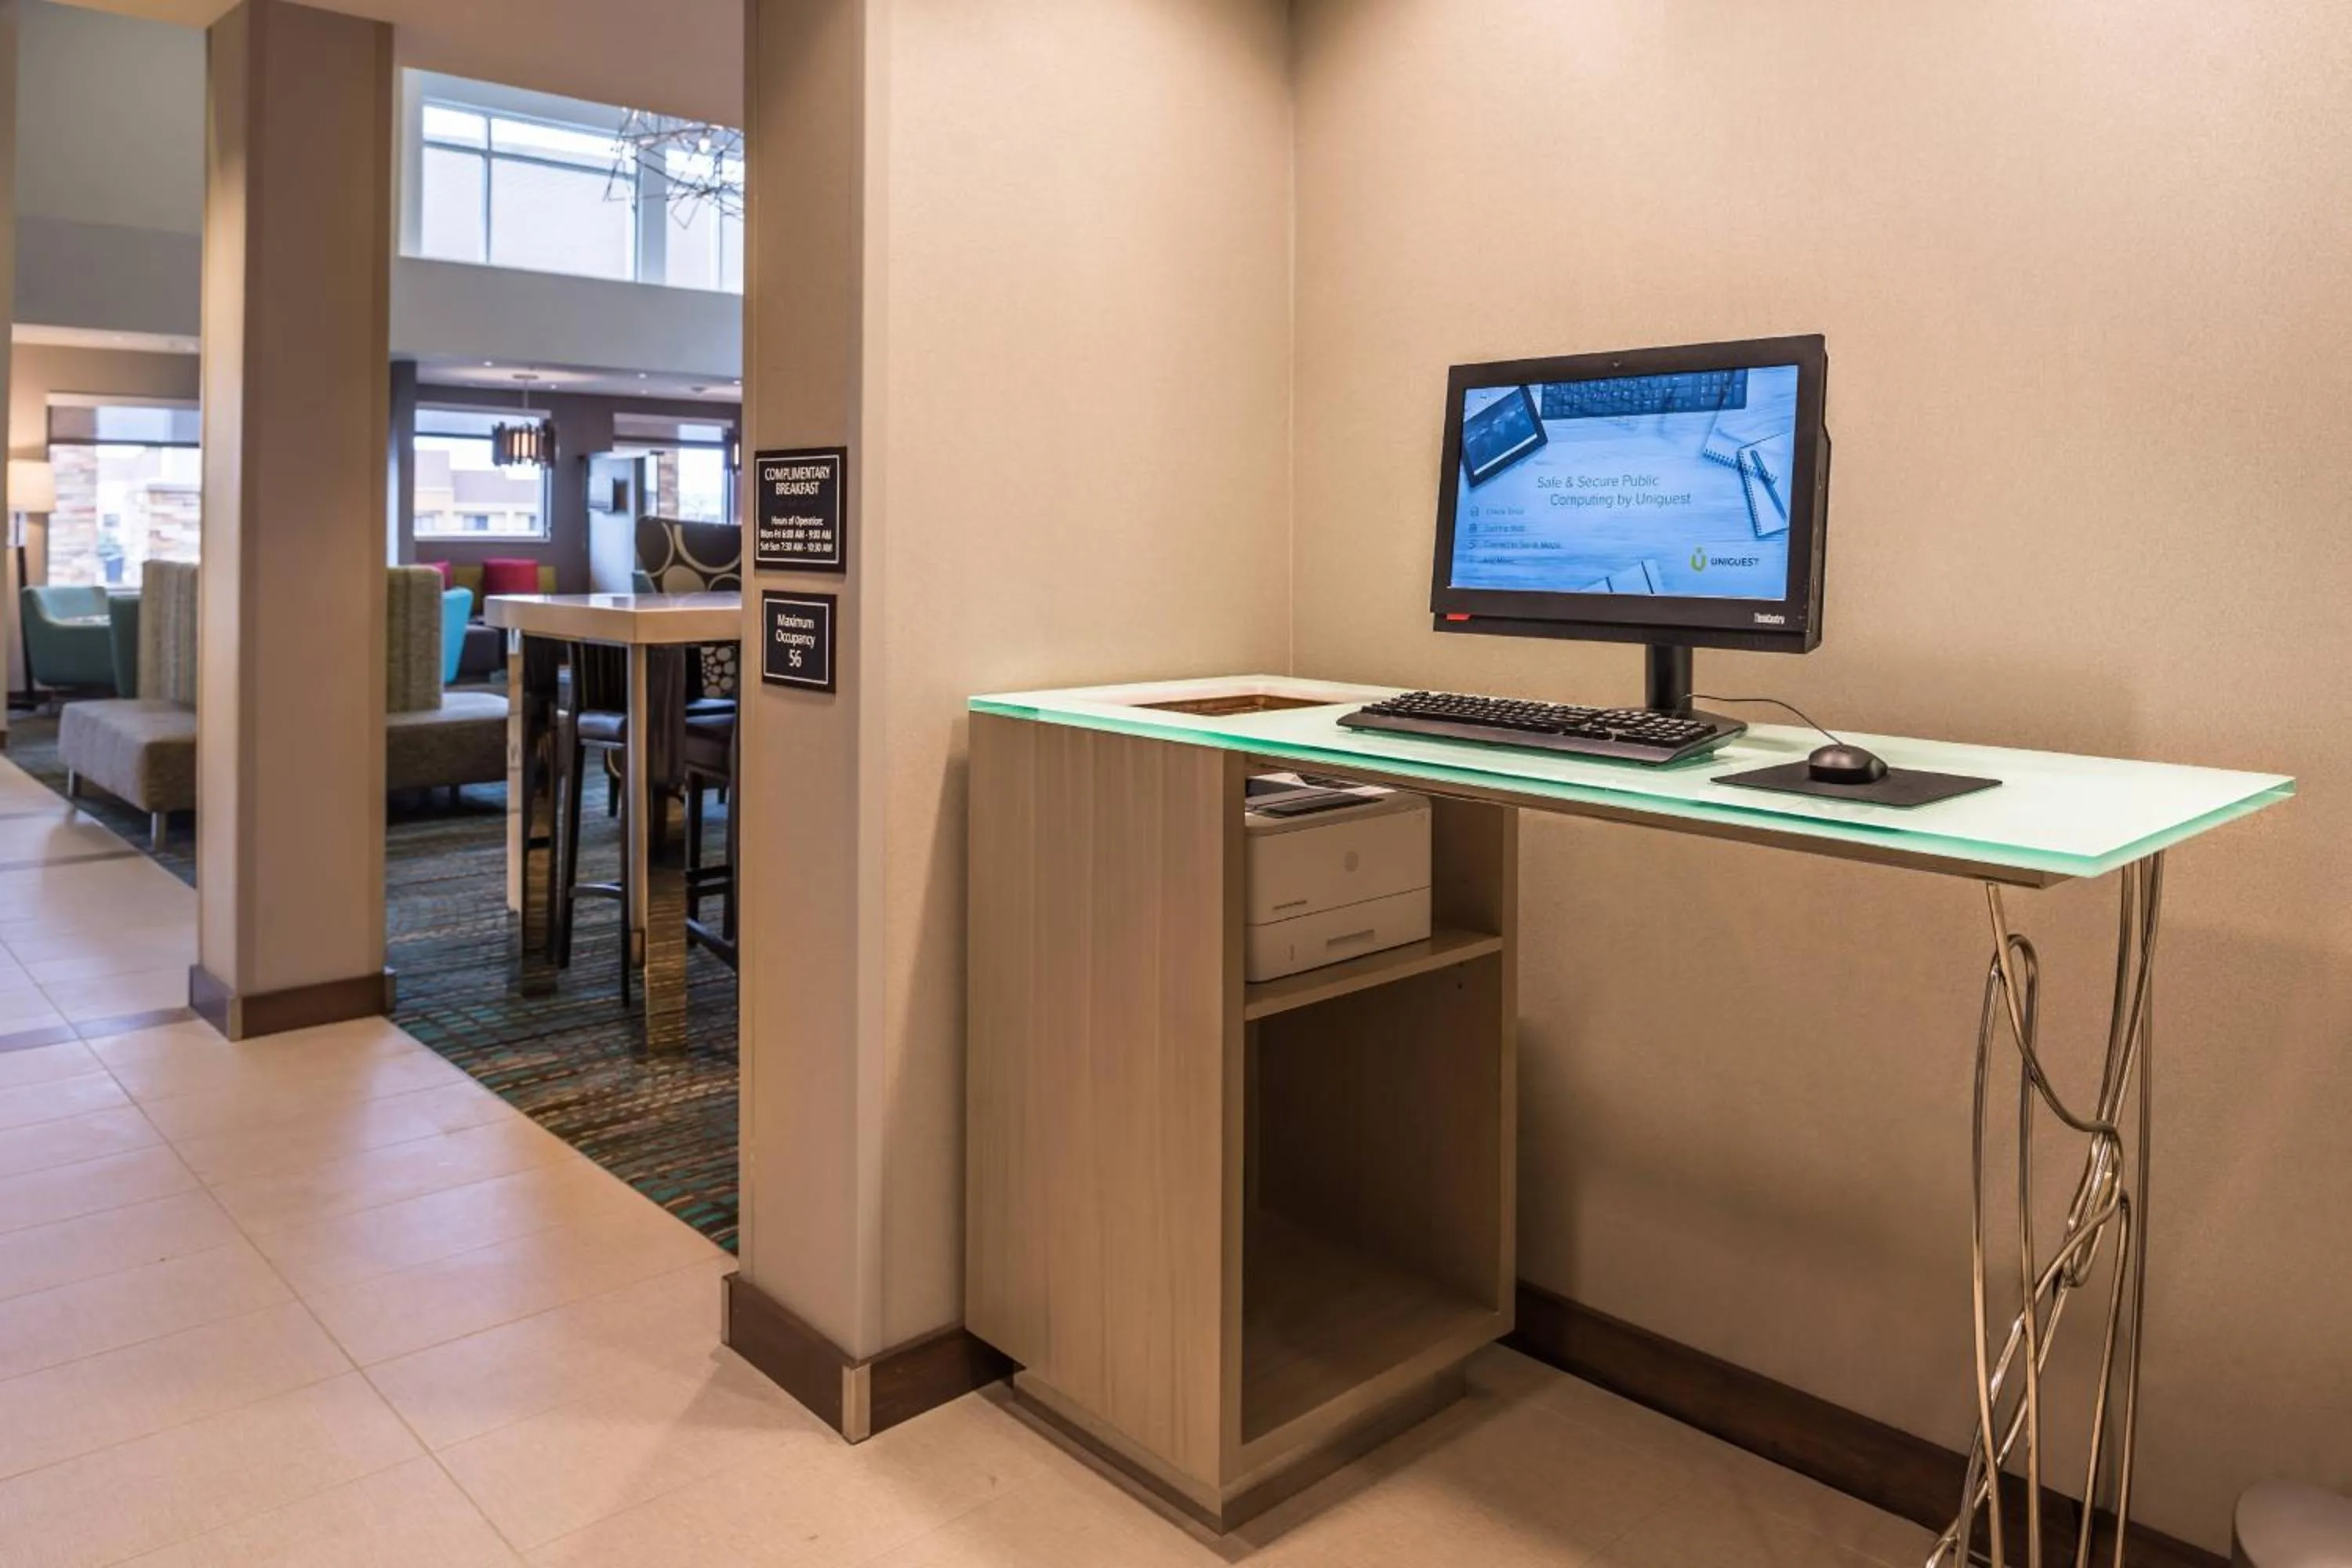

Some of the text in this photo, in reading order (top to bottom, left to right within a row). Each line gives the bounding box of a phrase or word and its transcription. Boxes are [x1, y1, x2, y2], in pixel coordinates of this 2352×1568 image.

[765, 466, 830, 481] COMPLIMENTARY
[775, 481, 819, 495] BREAKFAST
[1537, 474, 1660, 488] Safe & Secure Public
[1550, 492, 1691, 508] Computing by Uniguest
[795, 529, 805, 539] AM
[822, 529, 832, 540] AM
[793, 542, 804, 551] AM
[1710, 557, 1759, 567] UNIGUEST
[777, 613, 815, 630] Maximum
[775, 629, 816, 649] Occupancy
[789, 648, 802, 667] 56
